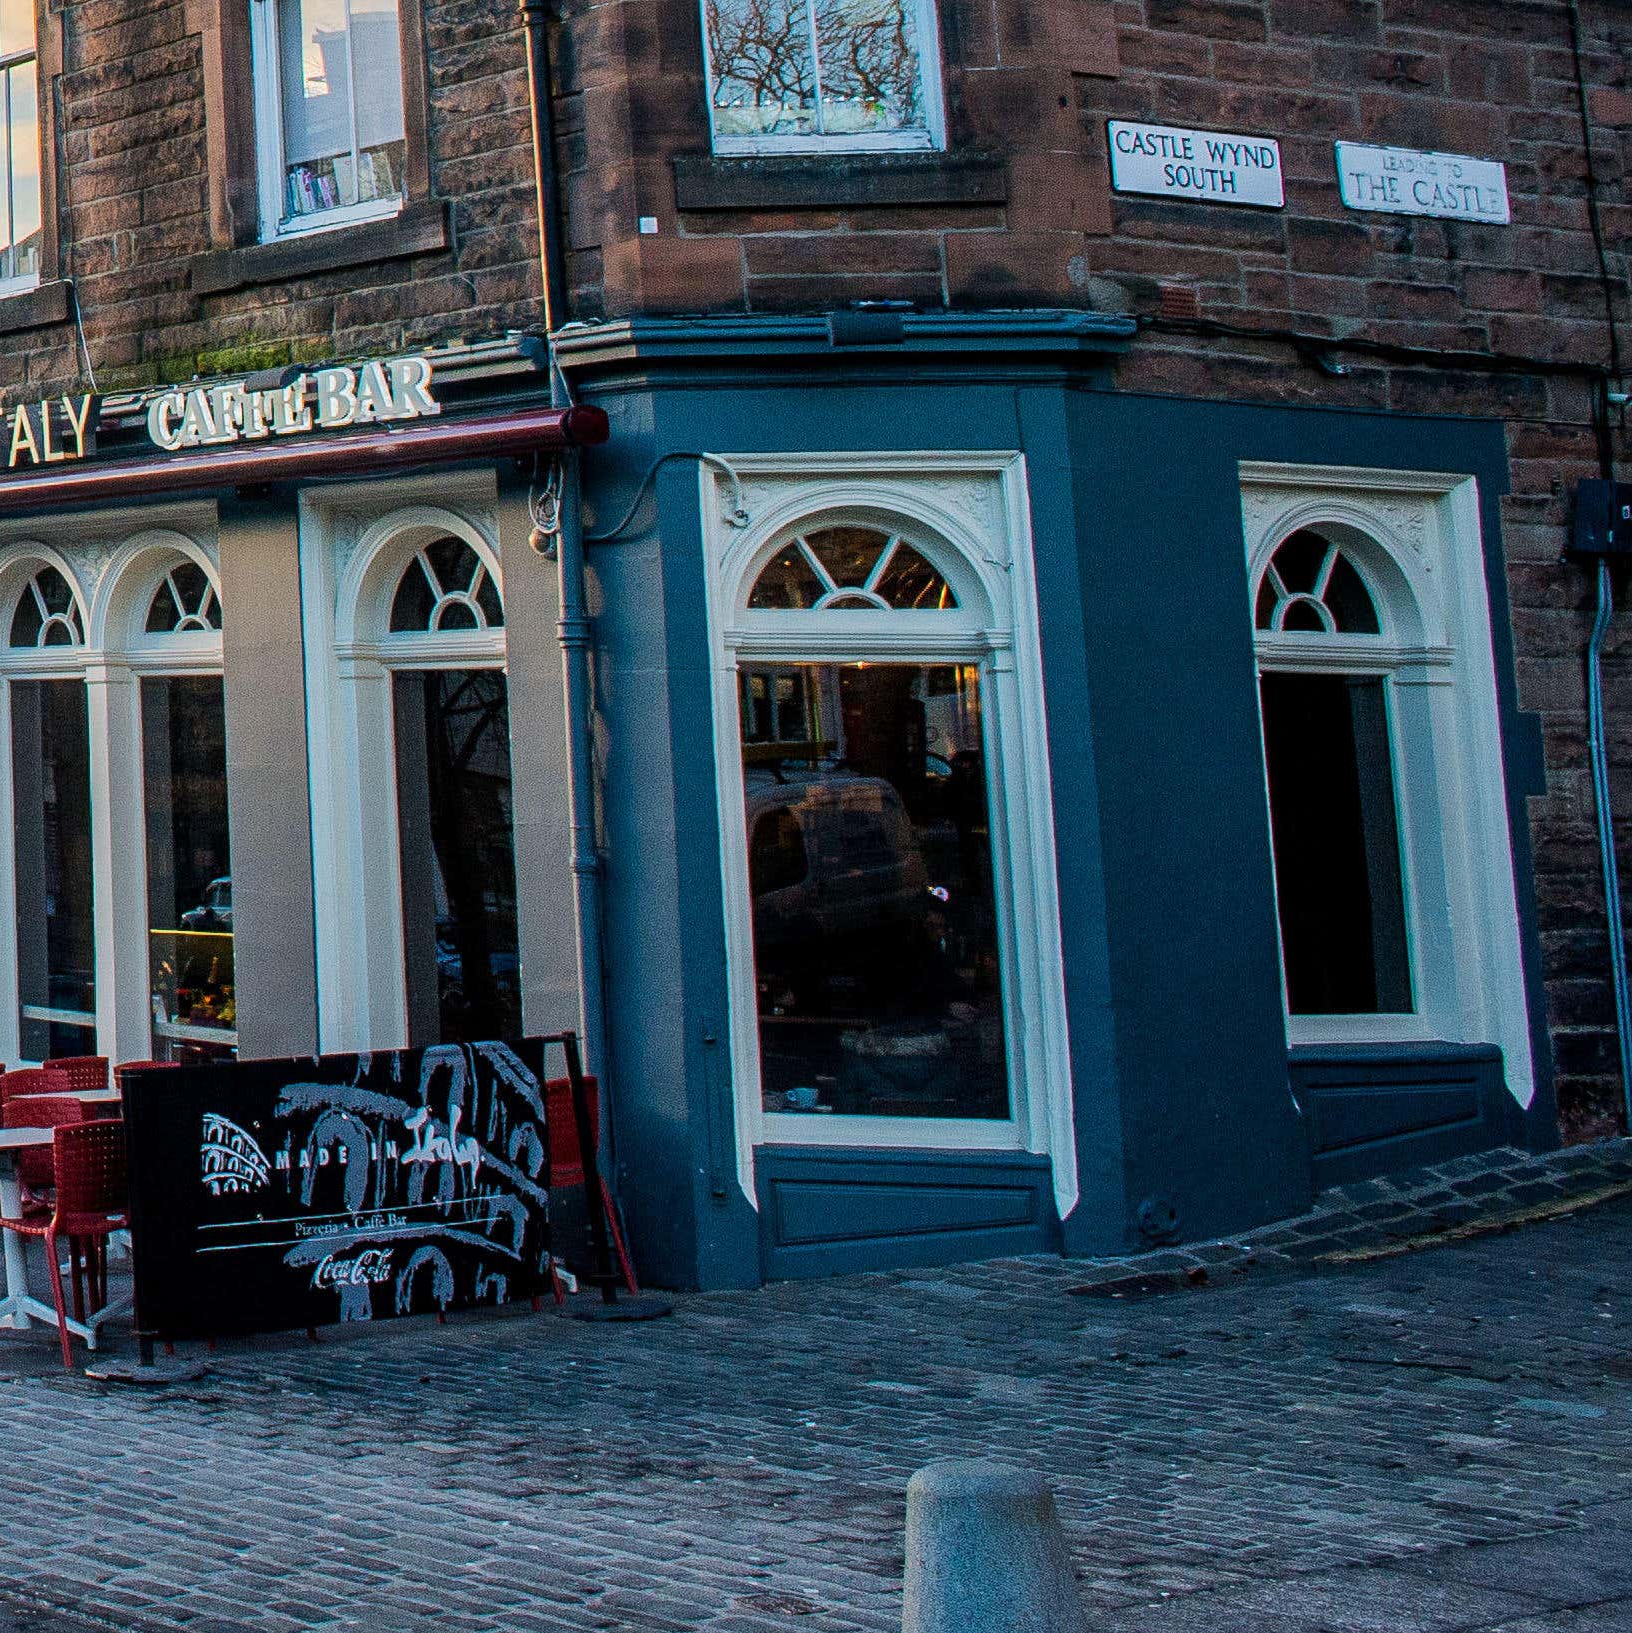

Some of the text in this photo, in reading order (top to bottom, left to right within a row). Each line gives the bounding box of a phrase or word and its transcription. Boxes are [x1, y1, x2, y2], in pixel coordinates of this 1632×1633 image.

[1115, 129, 1275, 170] CASTLE WYND
[1164, 163, 1237, 195] SOUTH
[1349, 171, 1401, 204] THE
[314, 356, 442, 429] BAR
[276, 1145, 348, 1169] MADE
[370, 1140, 397, 1161] IN
[295, 1220, 338, 1237] Pizzeria
[388, 1213, 408, 1227] Bar
[313, 1248, 395, 1289] Coca-Cola
